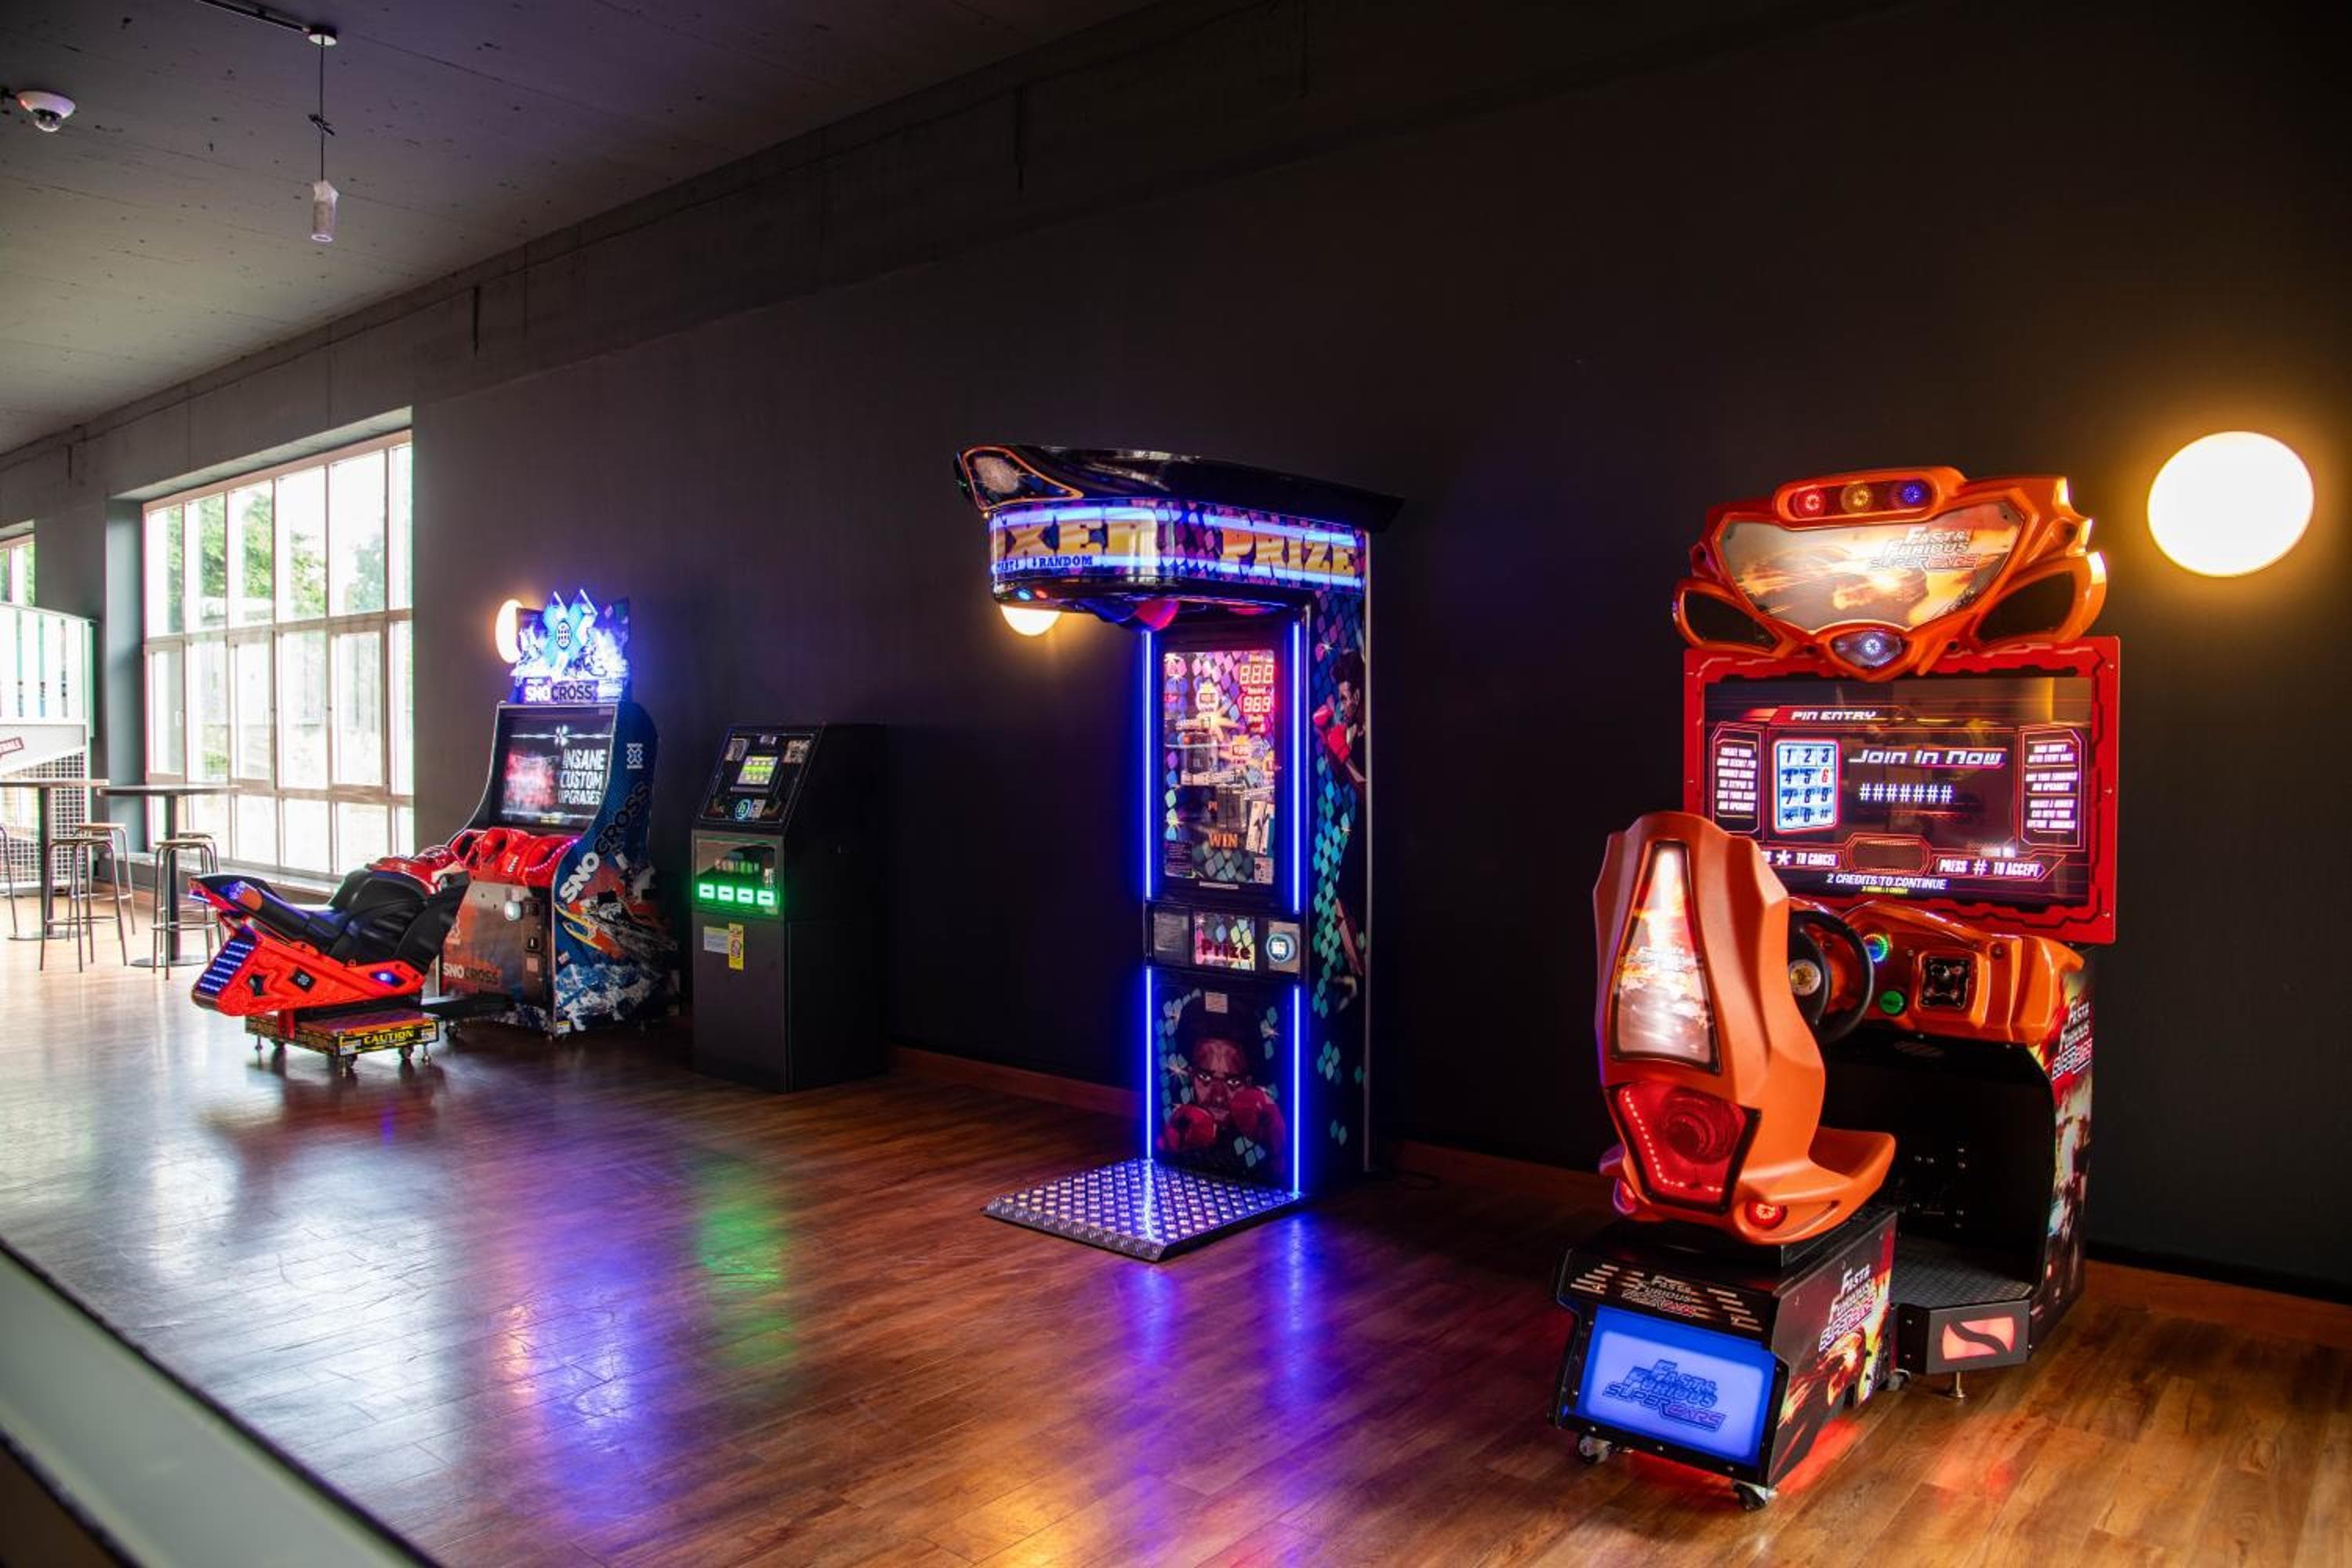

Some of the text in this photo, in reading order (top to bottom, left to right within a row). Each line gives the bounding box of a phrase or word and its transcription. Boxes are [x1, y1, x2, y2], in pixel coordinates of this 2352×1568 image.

[1039, 555, 1093, 567] RANDOM
[1791, 710, 1876, 720] PIN ENTRY
[562, 749, 606, 770] INSANE
[560, 770, 603, 789] CUSTOM
[557, 789, 601, 805] UPGRADES
[1939, 859, 1968, 873] PRESS
[2005, 862, 2041, 877] ACCEPT
[1827, 873, 1947, 890] 2 CREDITS TO CONTINUE
[1202, 938, 1251, 960] Prize
[363, 1029, 415, 1046] CAUTION
